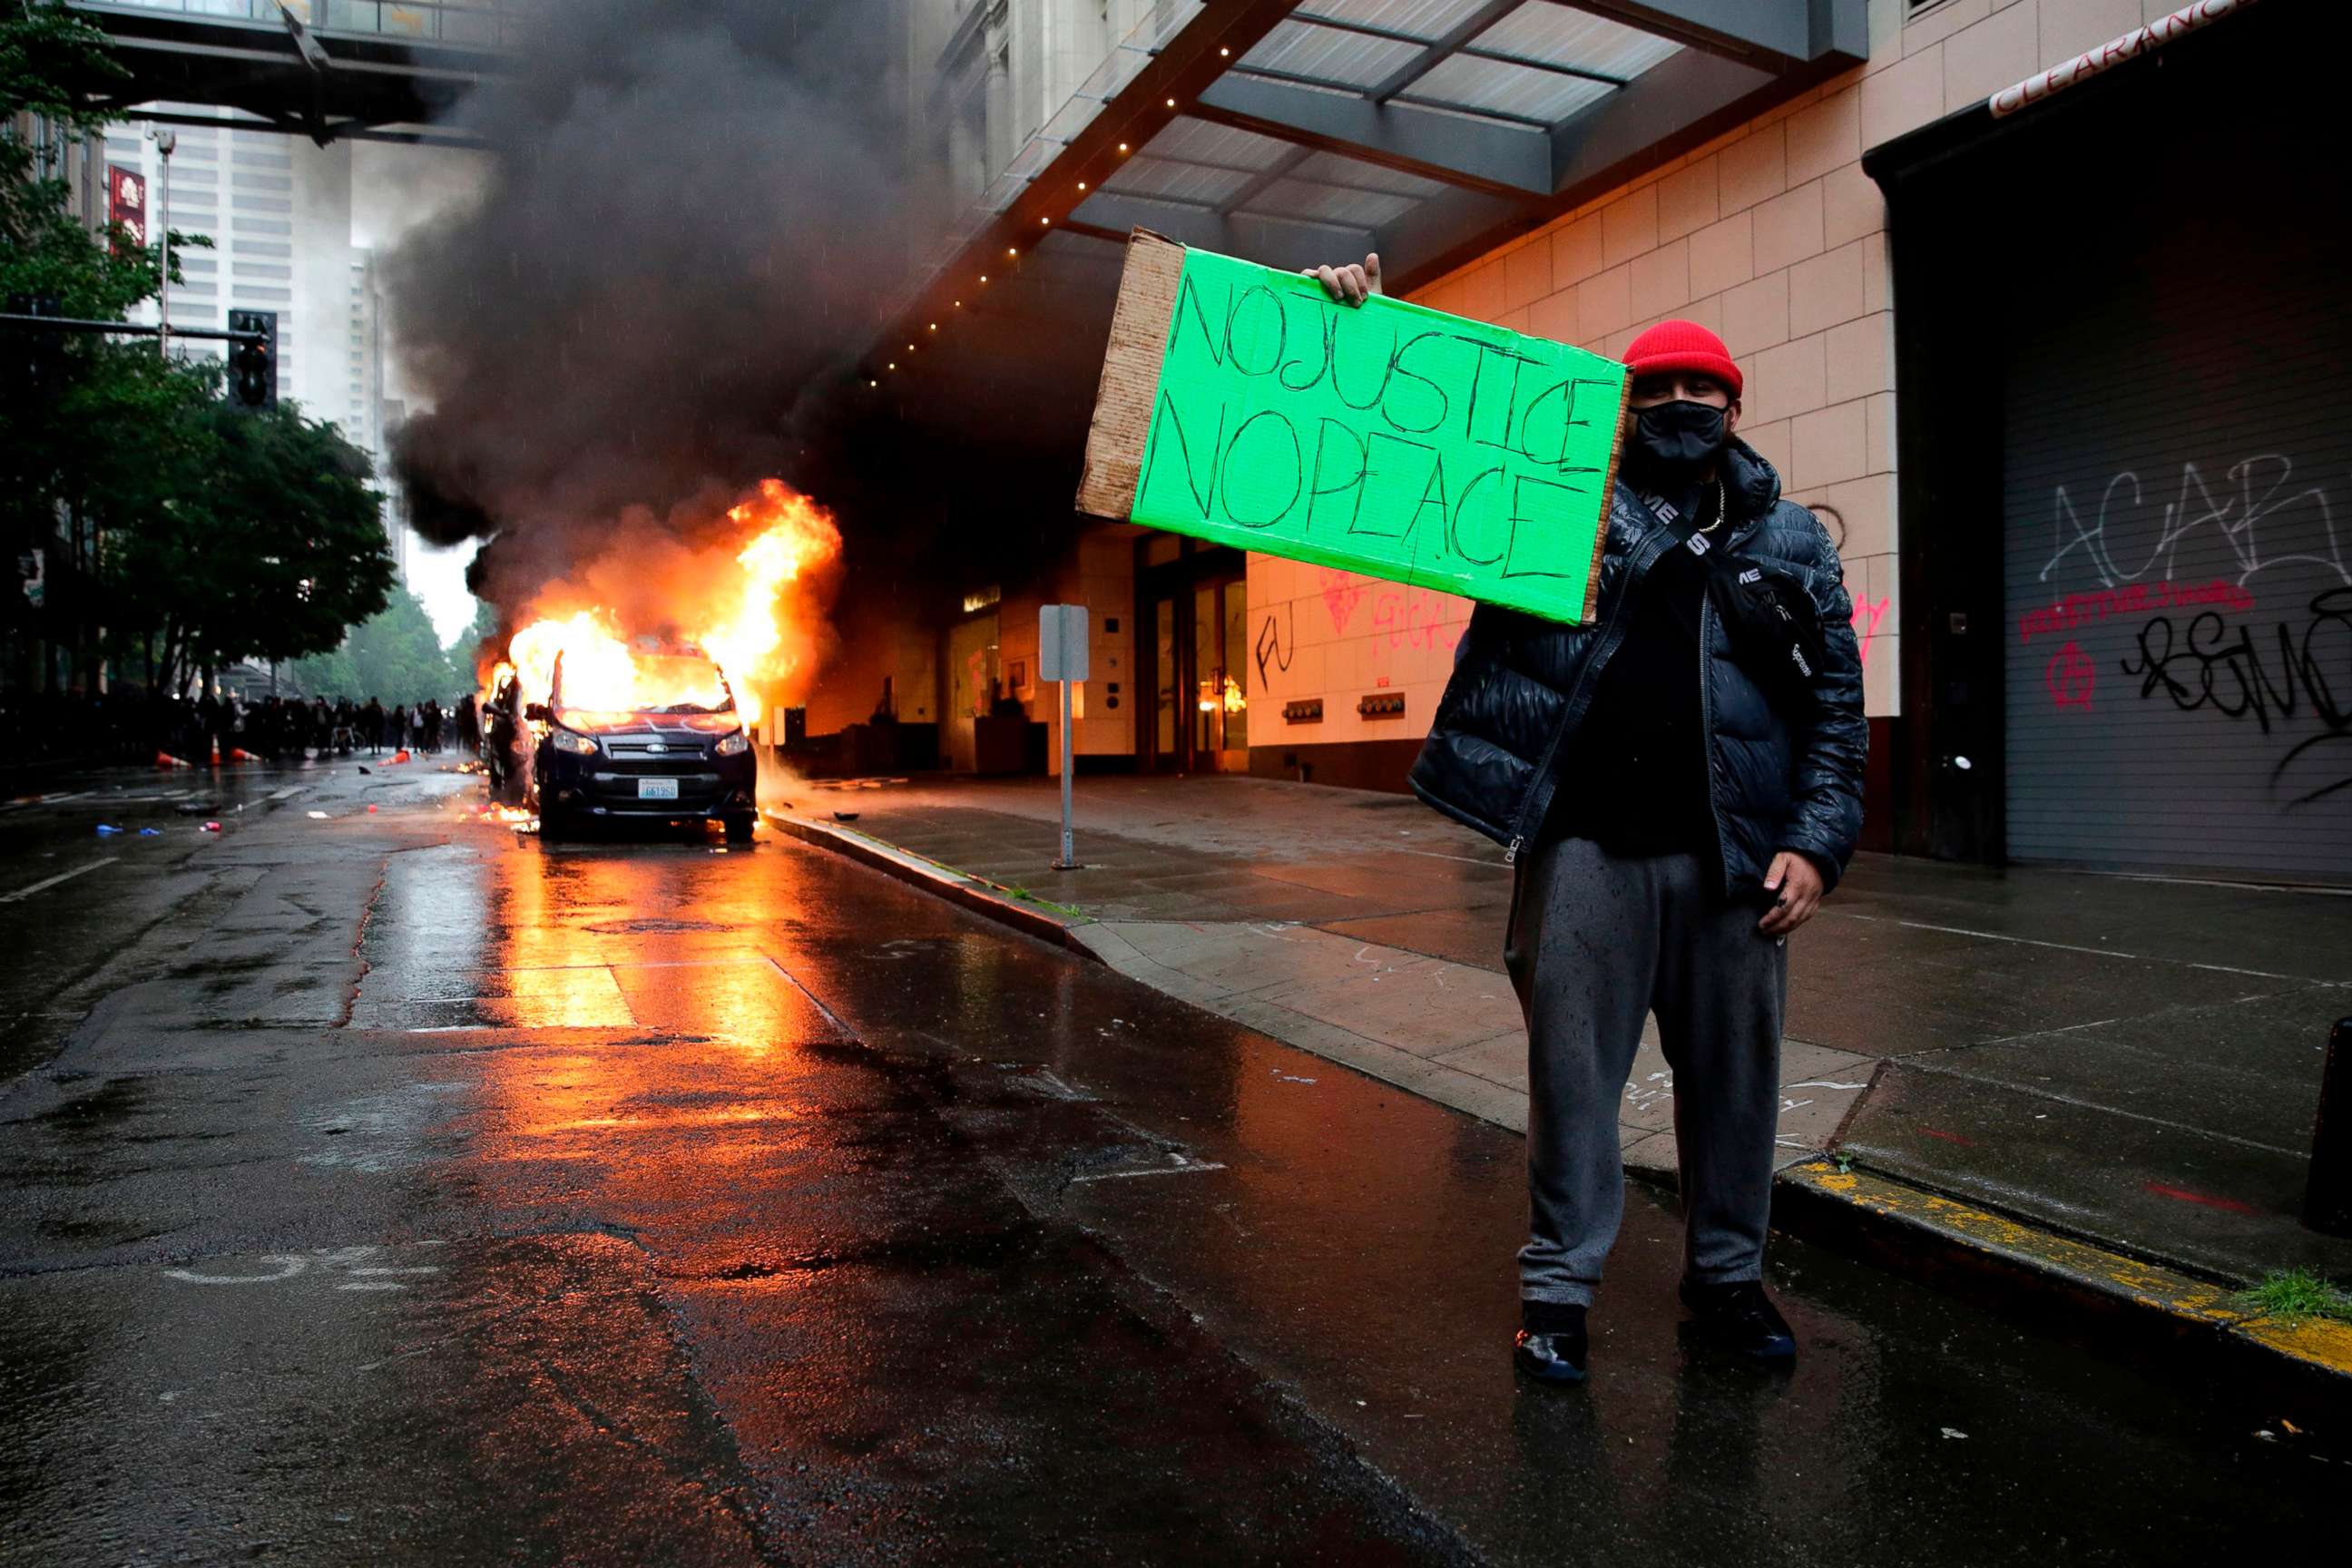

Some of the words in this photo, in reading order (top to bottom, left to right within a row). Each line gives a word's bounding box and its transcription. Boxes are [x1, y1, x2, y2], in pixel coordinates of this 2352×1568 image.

[1995, 0, 2256, 113] CLEARANC
[1170, 272, 1287, 377] NO
[1279, 290, 1619, 476] JUSTICE
[1140, 387, 1302, 528] NO
[1305, 416, 1590, 580] PEACE
[1791, 642, 1813, 678] Supreme
